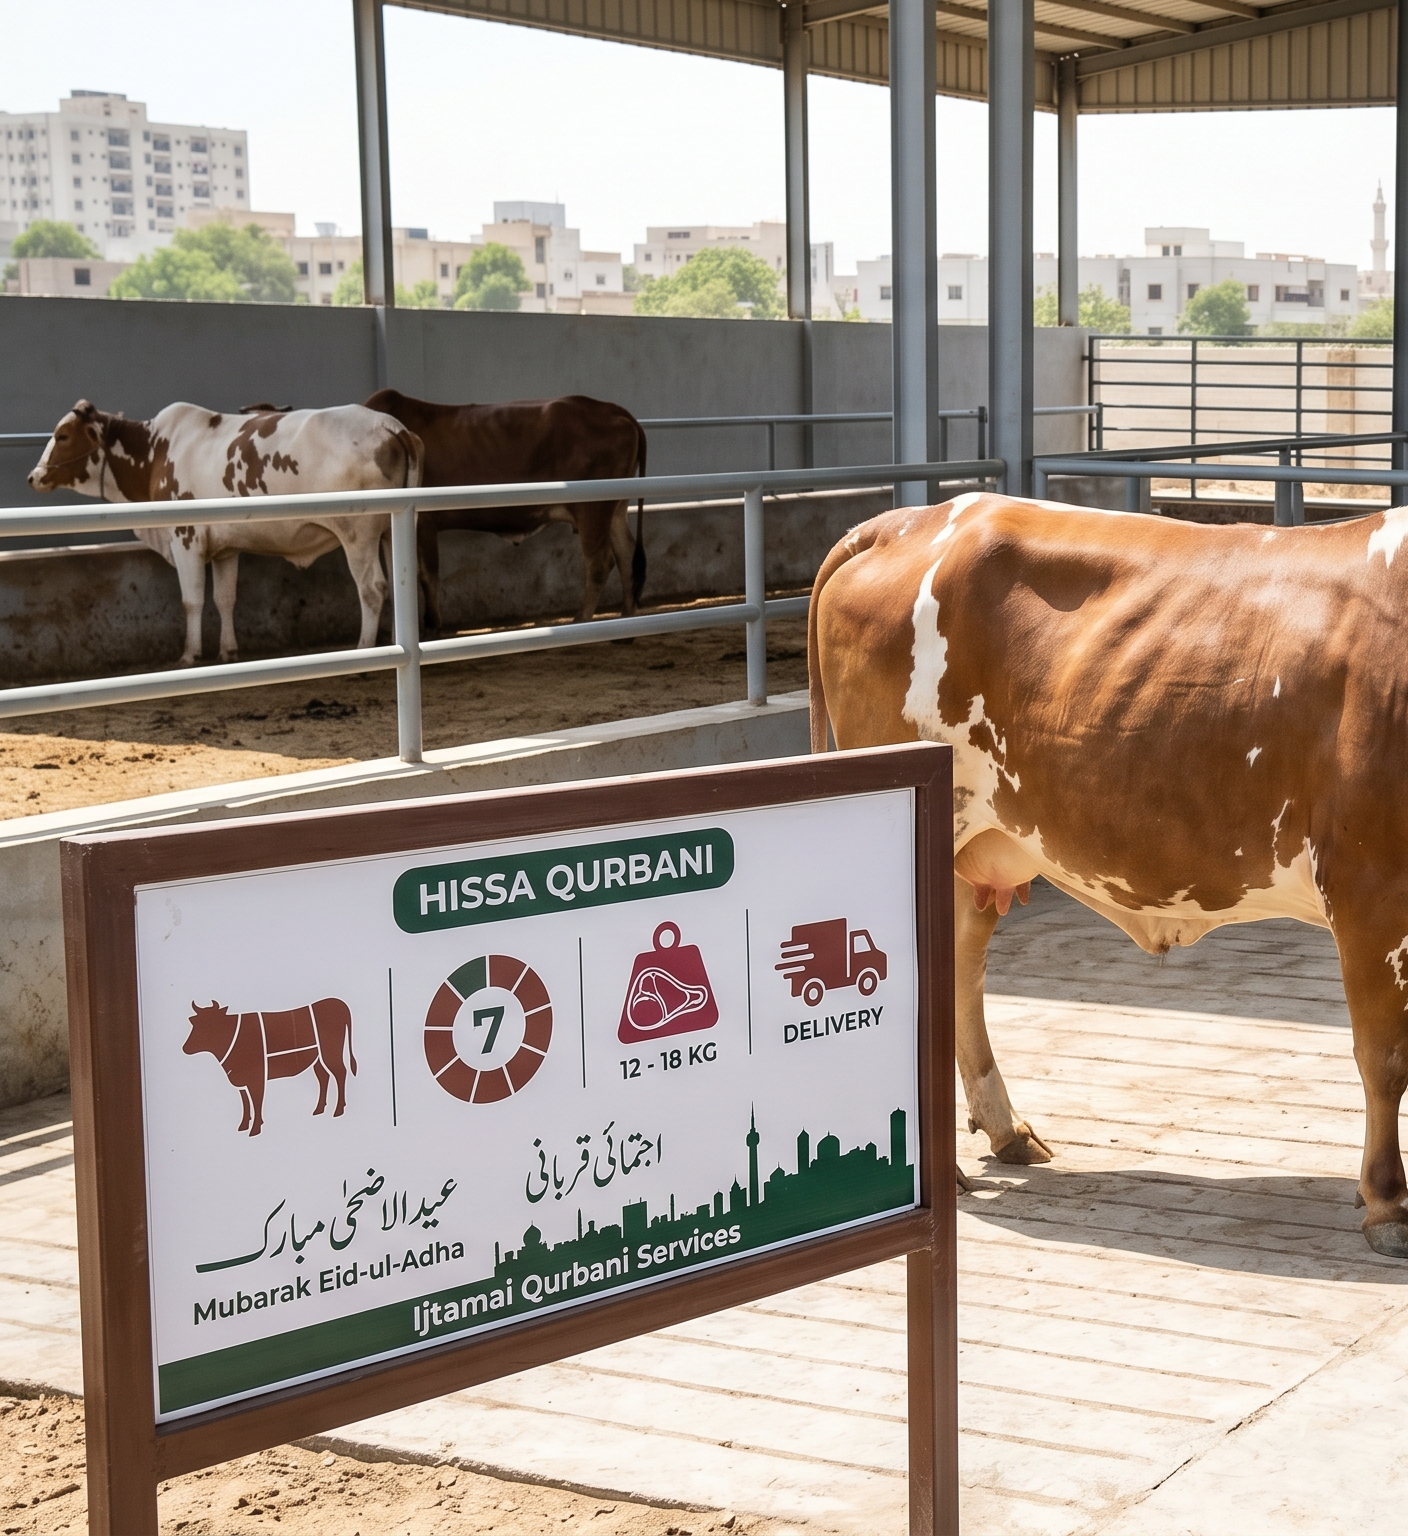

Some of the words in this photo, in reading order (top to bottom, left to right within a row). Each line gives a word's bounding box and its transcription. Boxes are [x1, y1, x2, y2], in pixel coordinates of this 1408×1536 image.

[419, 870, 536, 916] HISSA
[546, 844, 713, 902] QURBANI
[472, 1006, 506, 1056] 7
[783, 1006, 885, 1044] DELIVERY
[620, 1058, 642, 1081] 12
[659, 1048, 683, 1073] 18
[688, 1042, 718, 1067] KG
[525, 1133, 592, 1204] قربانی
[193, 1276, 311, 1326] Mubarak
[319, 1239, 466, 1296] Eid-ul-Adha
[413, 1278, 513, 1337] Ijtamai
[521, 1247, 629, 1303] Qurbani
[637, 1224, 742, 1269] Services
